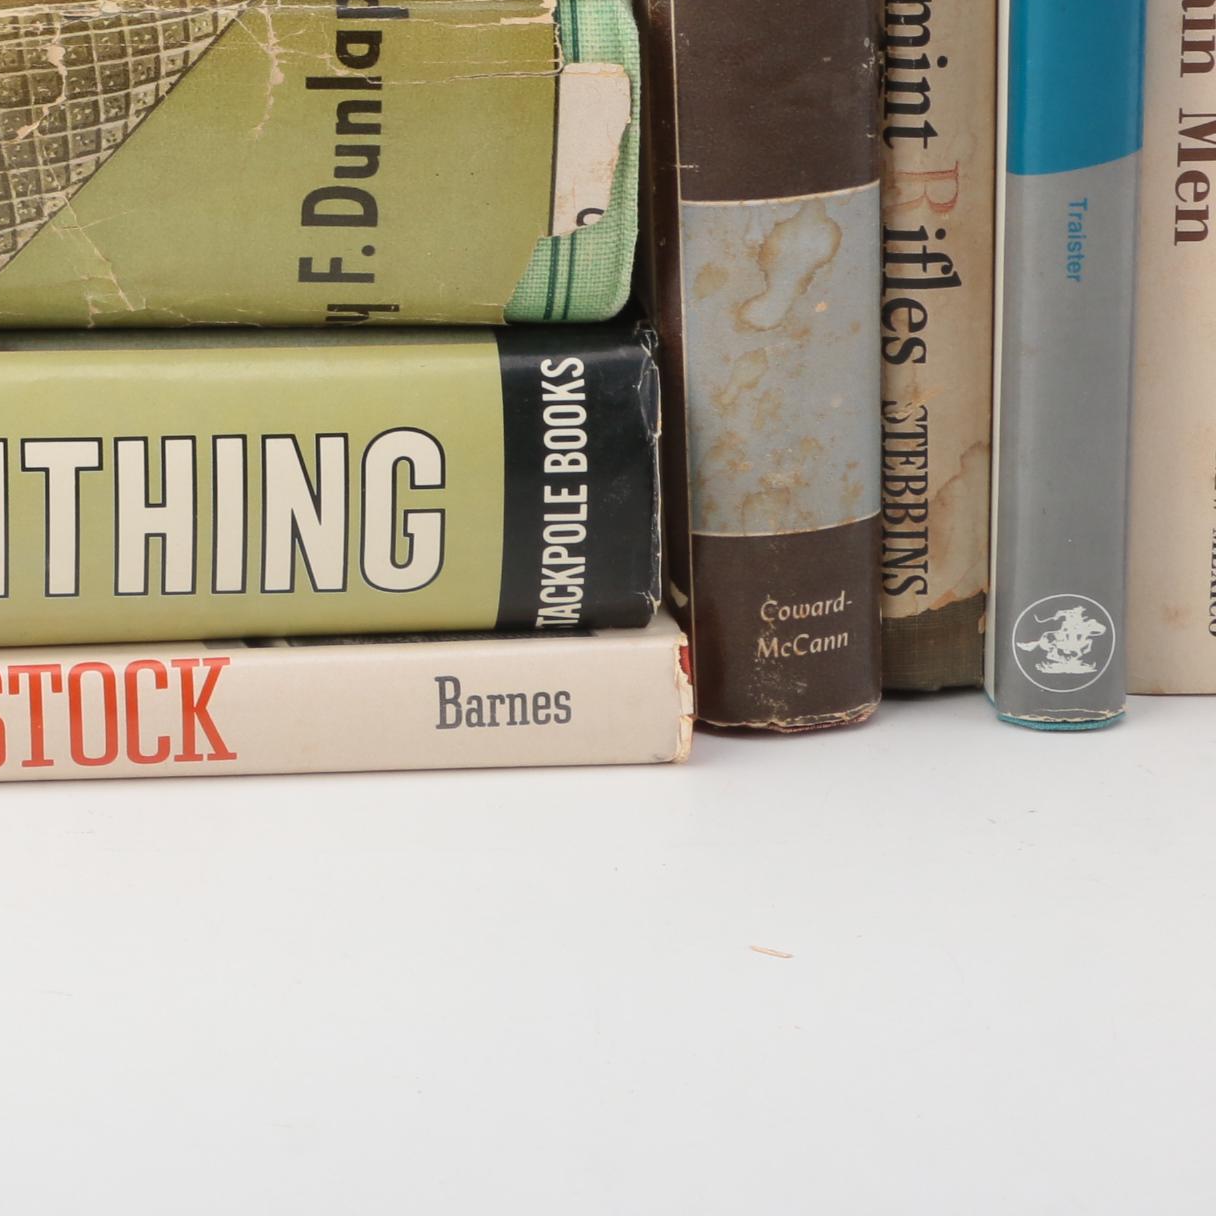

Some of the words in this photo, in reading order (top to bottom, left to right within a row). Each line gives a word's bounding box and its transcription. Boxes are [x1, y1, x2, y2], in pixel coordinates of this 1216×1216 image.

[1173, 107, 1216, 247] Men
[297, 245, 376, 284] F.
[883, 161, 963, 366] Rifles
[1066, 198, 1088, 283] Traister
[540, 357, 588, 472] BOOKS
[882, 400, 930, 597] STEBBINS
[536, 484, 588, 629] TACKPOLE
[760, 588, 853, 624] Coward-
[757, 630, 849, 660] McCann
[433, 674, 573, 730] Barnes
